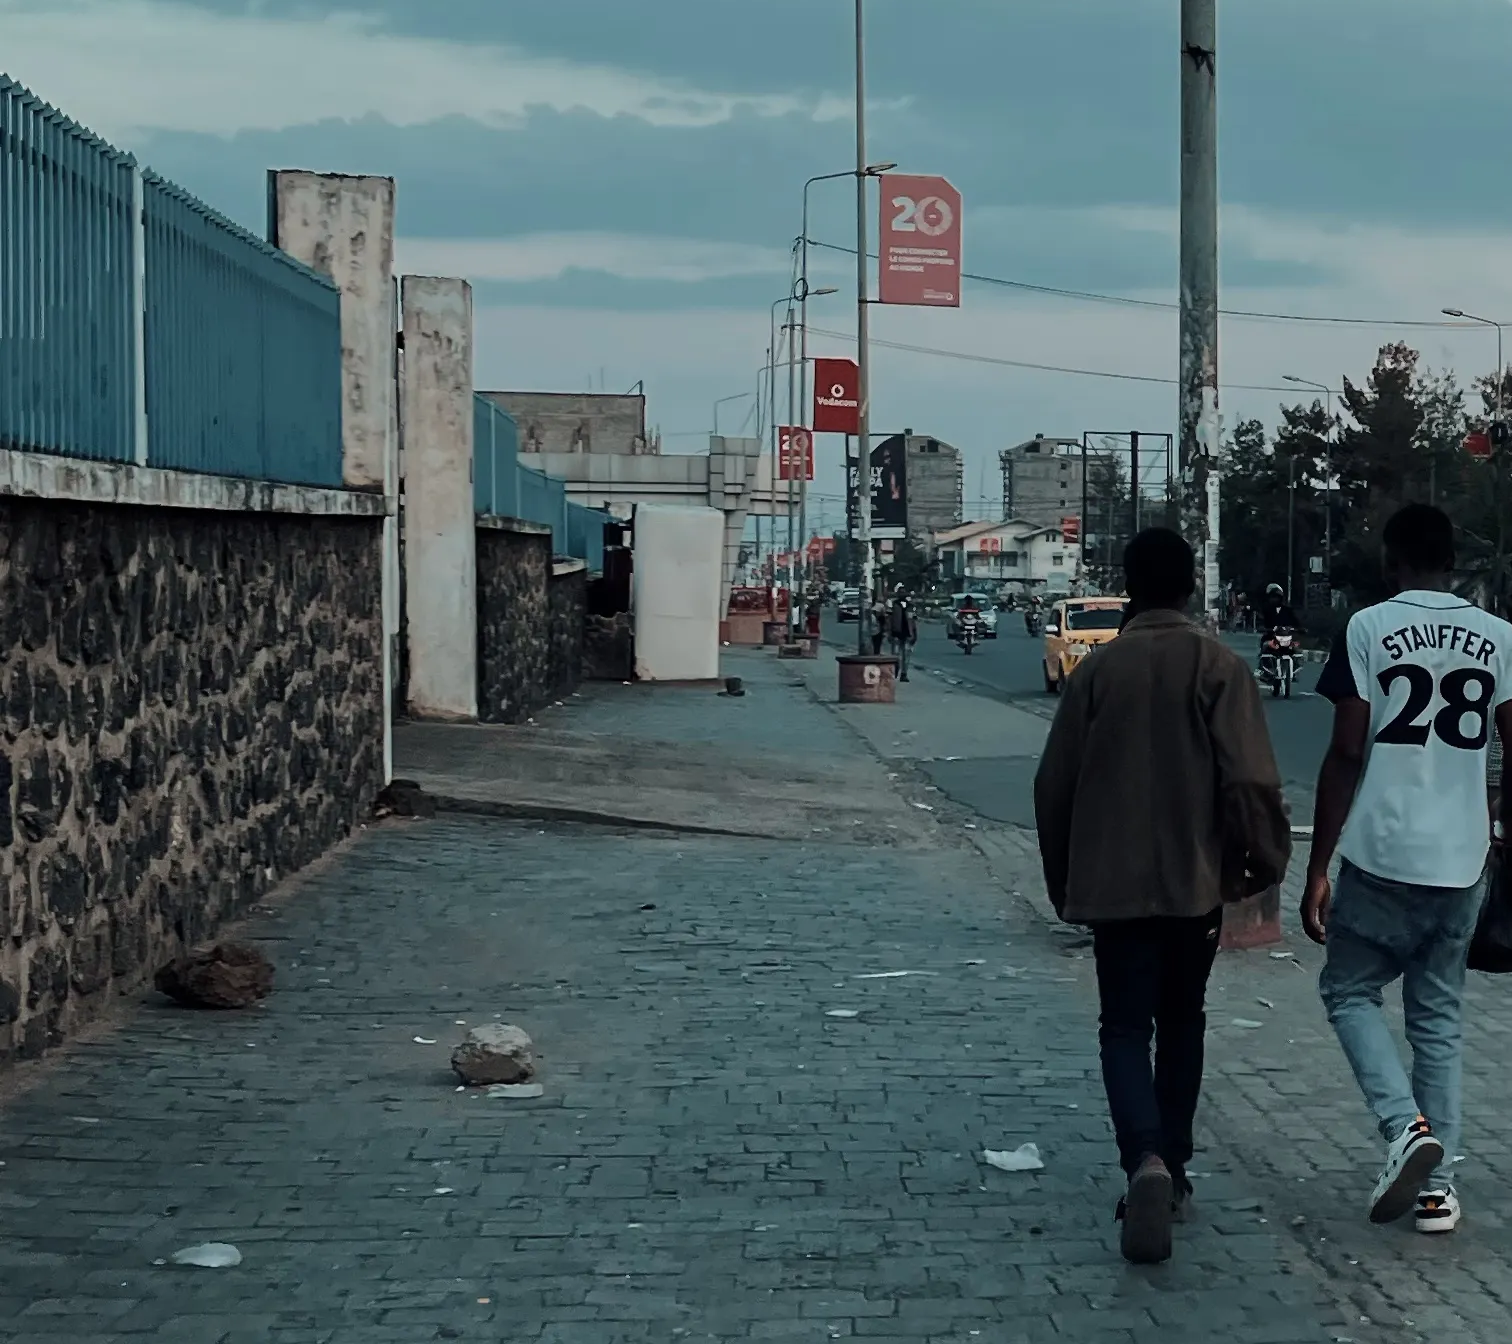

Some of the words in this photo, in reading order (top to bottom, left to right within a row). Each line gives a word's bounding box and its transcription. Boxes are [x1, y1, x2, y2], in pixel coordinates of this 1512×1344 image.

[891, 196, 953, 236] 20
[816, 396, 858, 407] Vodacom
[1382, 624, 1496, 666] STAUFFER
[1374, 663, 1495, 751] 28
